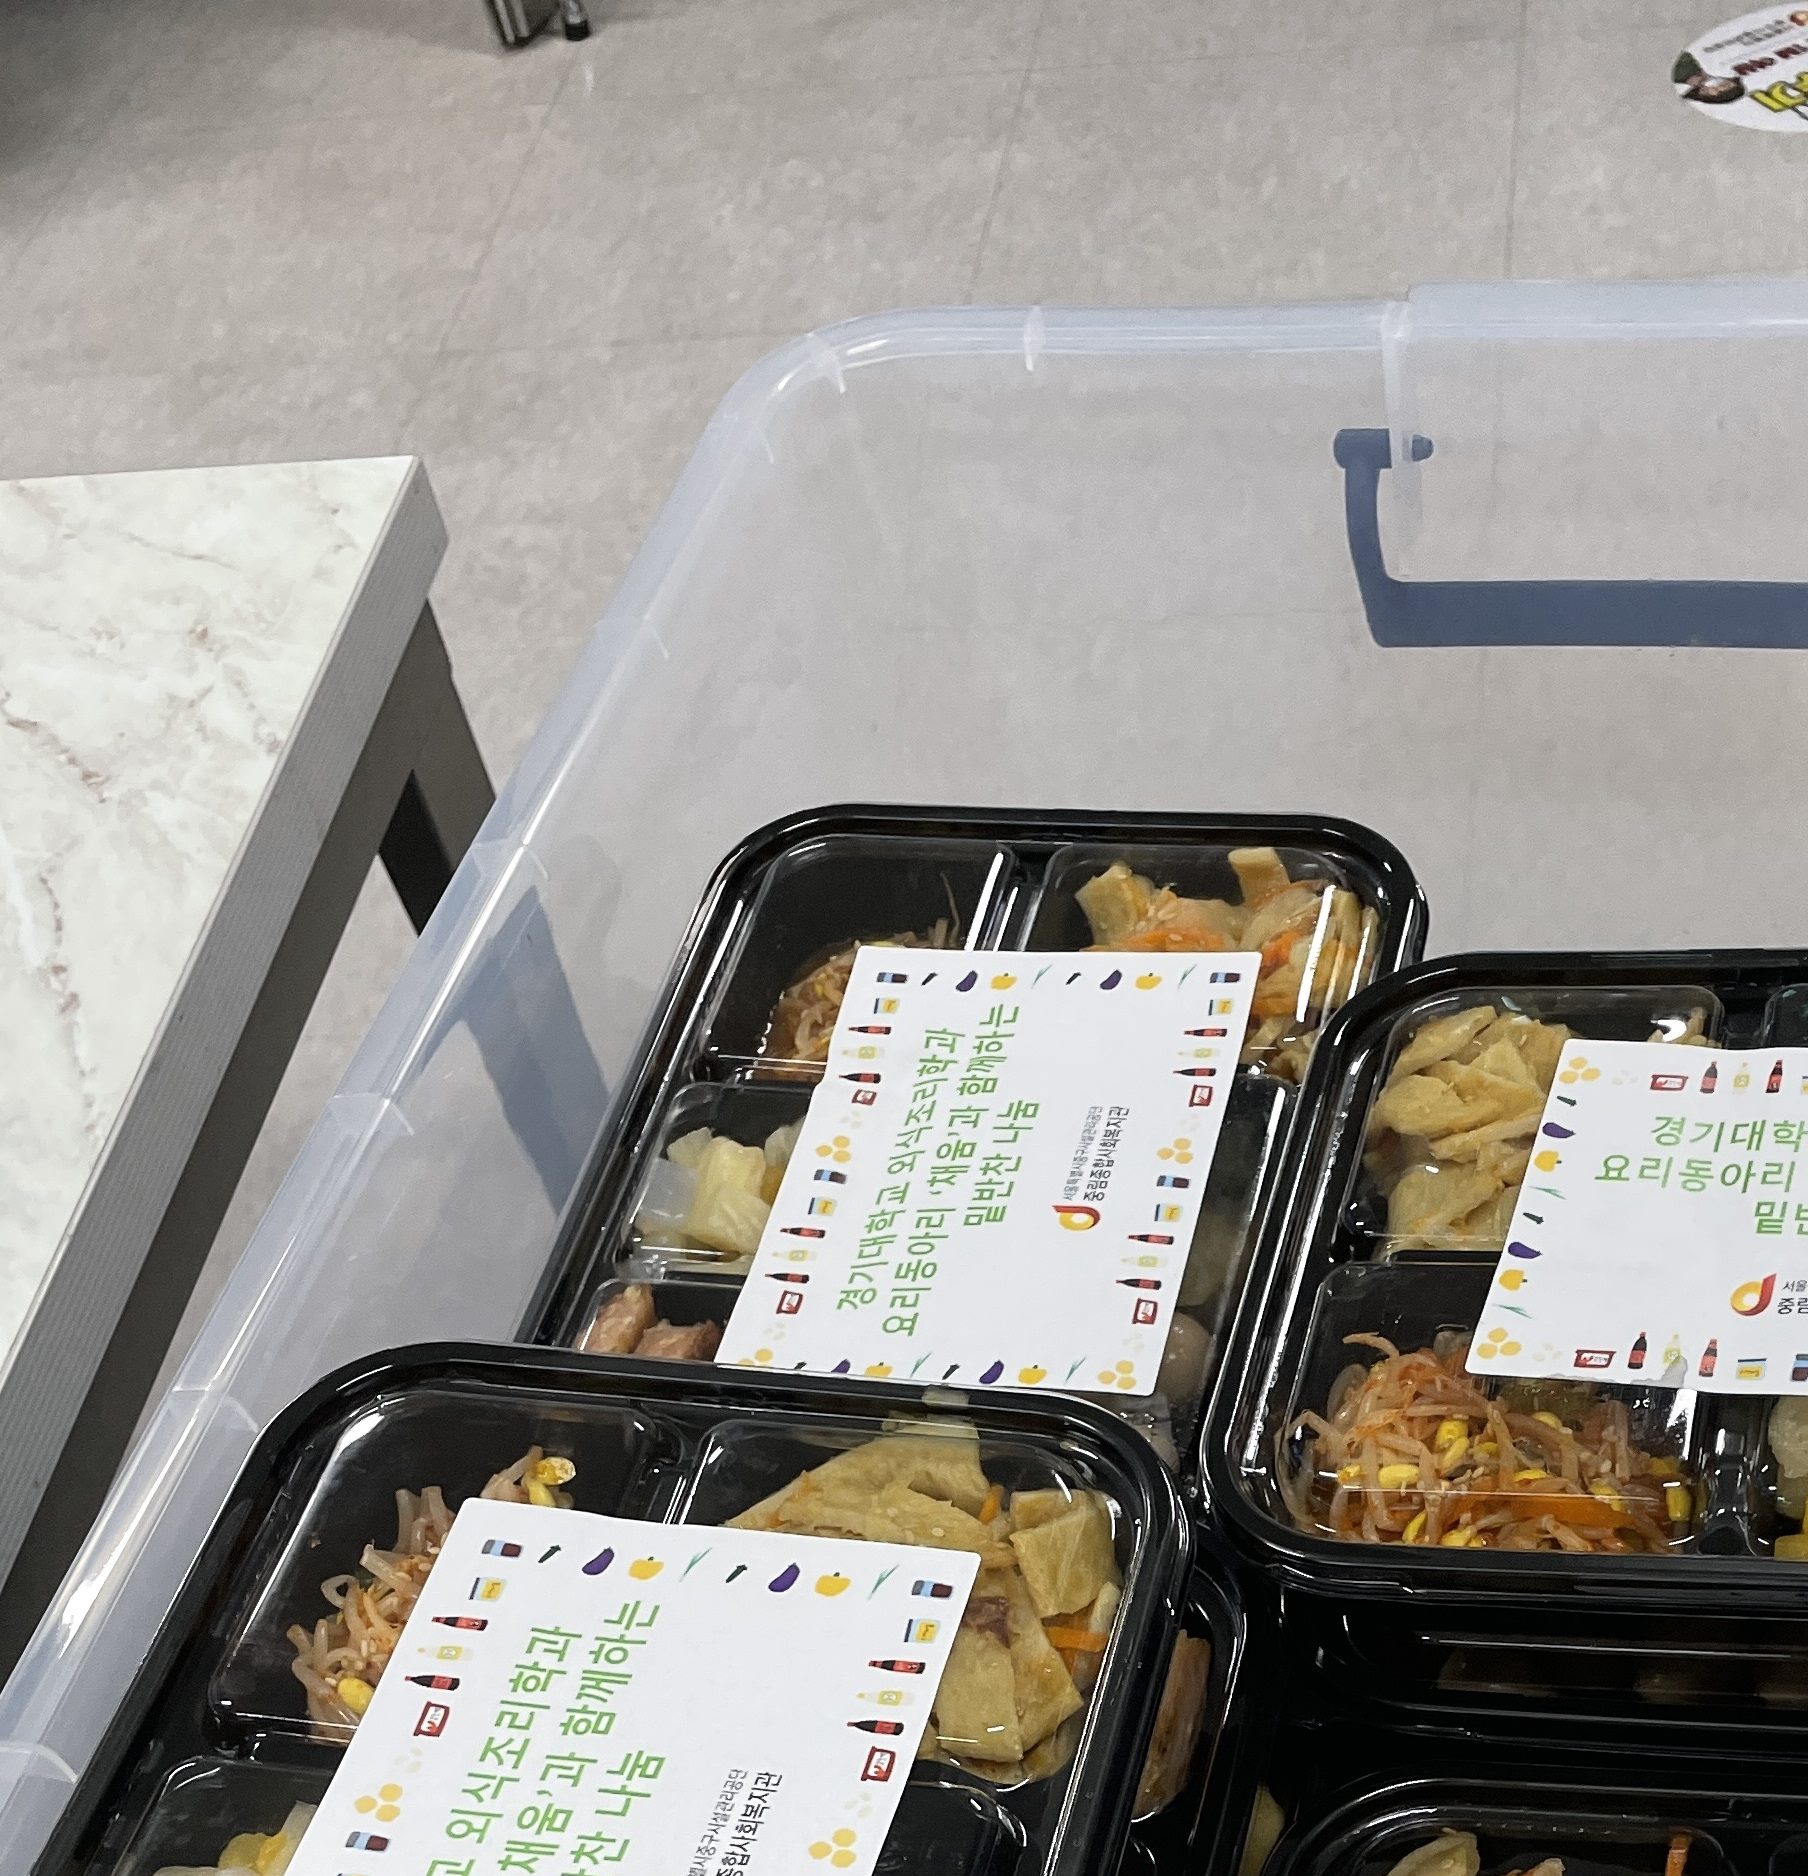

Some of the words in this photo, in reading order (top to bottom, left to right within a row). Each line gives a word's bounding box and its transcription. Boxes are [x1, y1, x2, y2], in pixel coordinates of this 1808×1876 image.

[834, 1180, 911, 1311] 경기대학교
[885, 1026, 966, 1175] 외식조리학과
[880, 1206, 957, 1337] 요리동아리
[954, 1002, 1020, 1096] 함께하는
[991, 1098, 1041, 1144] 나눔
[1081, 1104, 1130, 1202] 중림종합사회복지관
[961, 1151, 1023, 1227] 밑반찬
[1593, 1153, 1796, 1194] 요리동아리
[557, 1598, 661, 1736] 함께하는
[444, 1625, 583, 1845] 외식조리학과
[593, 1748, 667, 1818] 나눔
